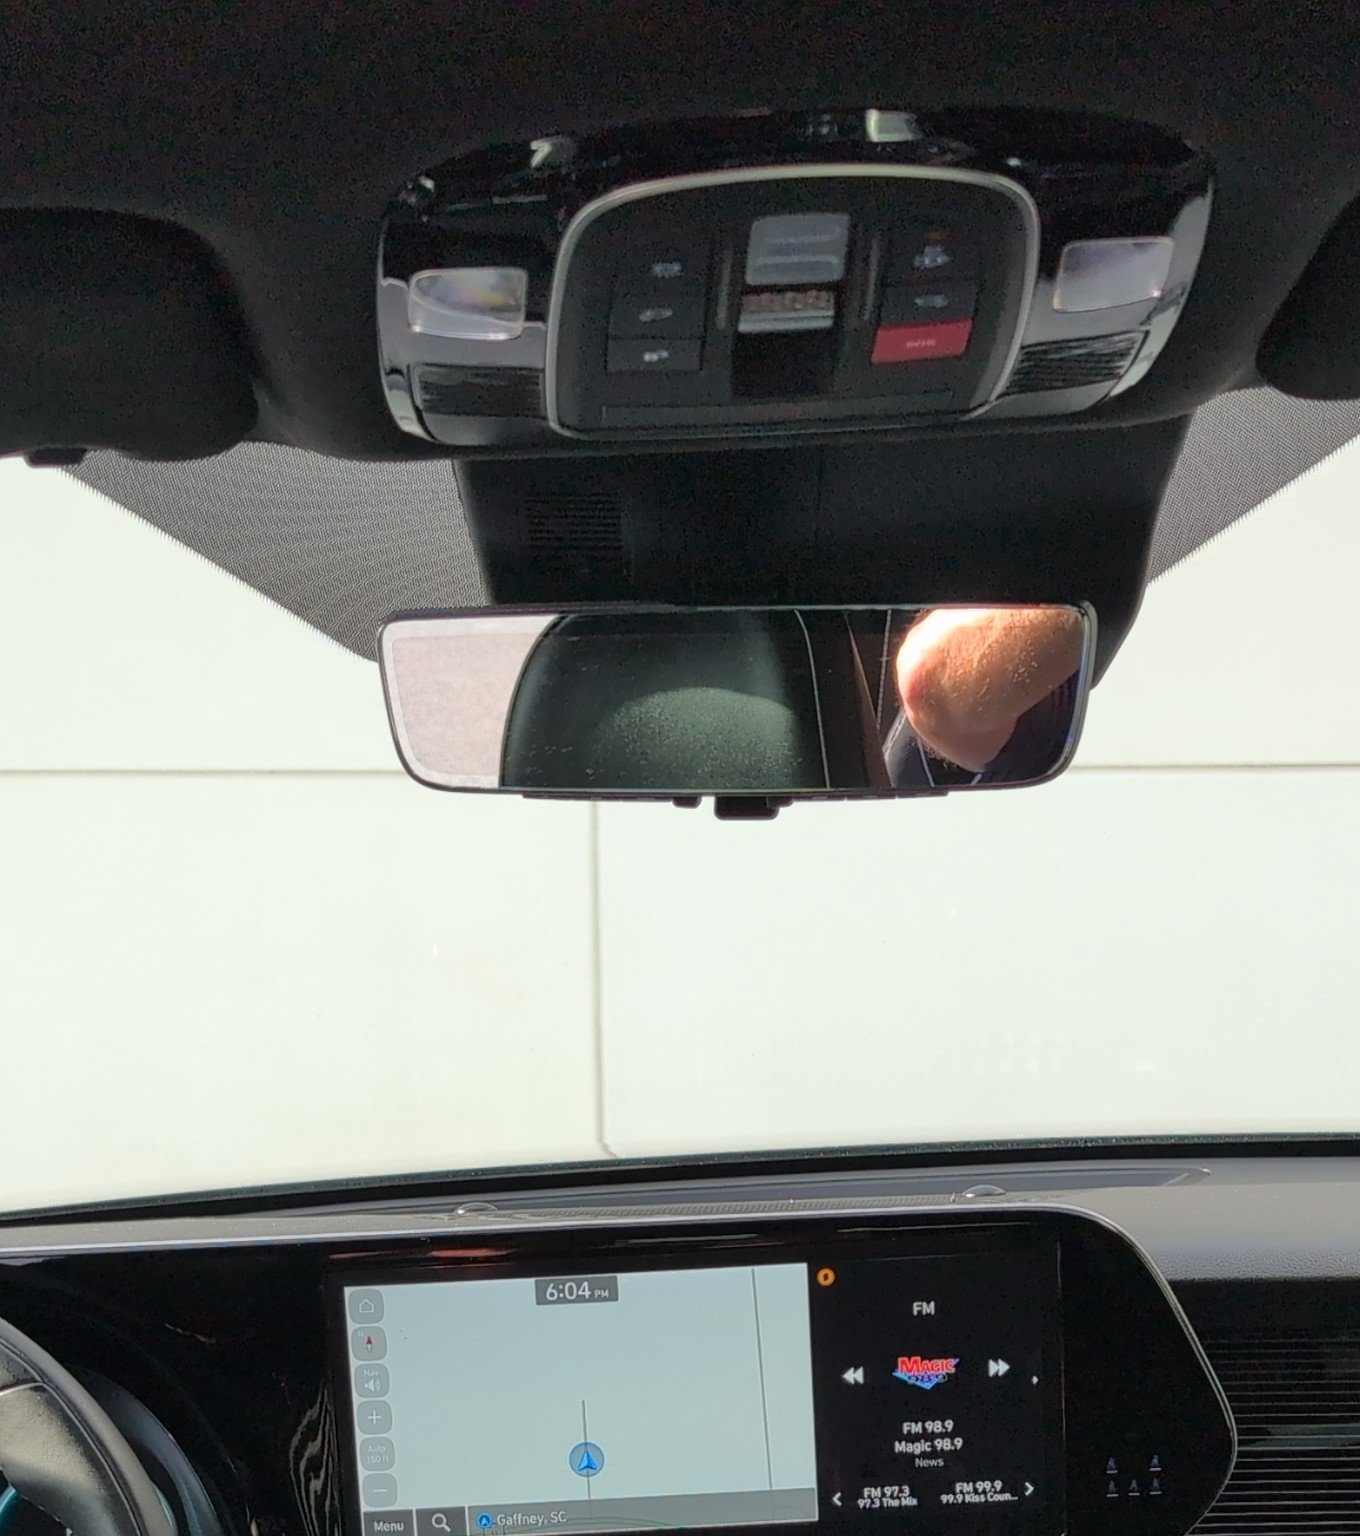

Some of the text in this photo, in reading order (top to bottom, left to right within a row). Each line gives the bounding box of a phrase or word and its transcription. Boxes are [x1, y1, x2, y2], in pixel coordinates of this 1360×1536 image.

[545, 1281, 610, 1301] 6:04 PM
[912, 1301, 936, 1316] FM
[902, 1419, 955, 1435] FM 98.9
[893, 1437, 964, 1455] Magic 98.9
[914, 1457, 945, 1468] News
[863, 1485, 911, 1498] FM 97.3
[955, 1480, 1003, 1494] FM 99.9
[856, 1496, 919, 1510] 97.3 The Mix
[940, 1493, 964, 1504] 99.9
[964, 1492, 986, 1503] Kiss
[374, 1519, 405, 1534] Menu
[496, 1510, 568, 1528] Gaffney, SC
